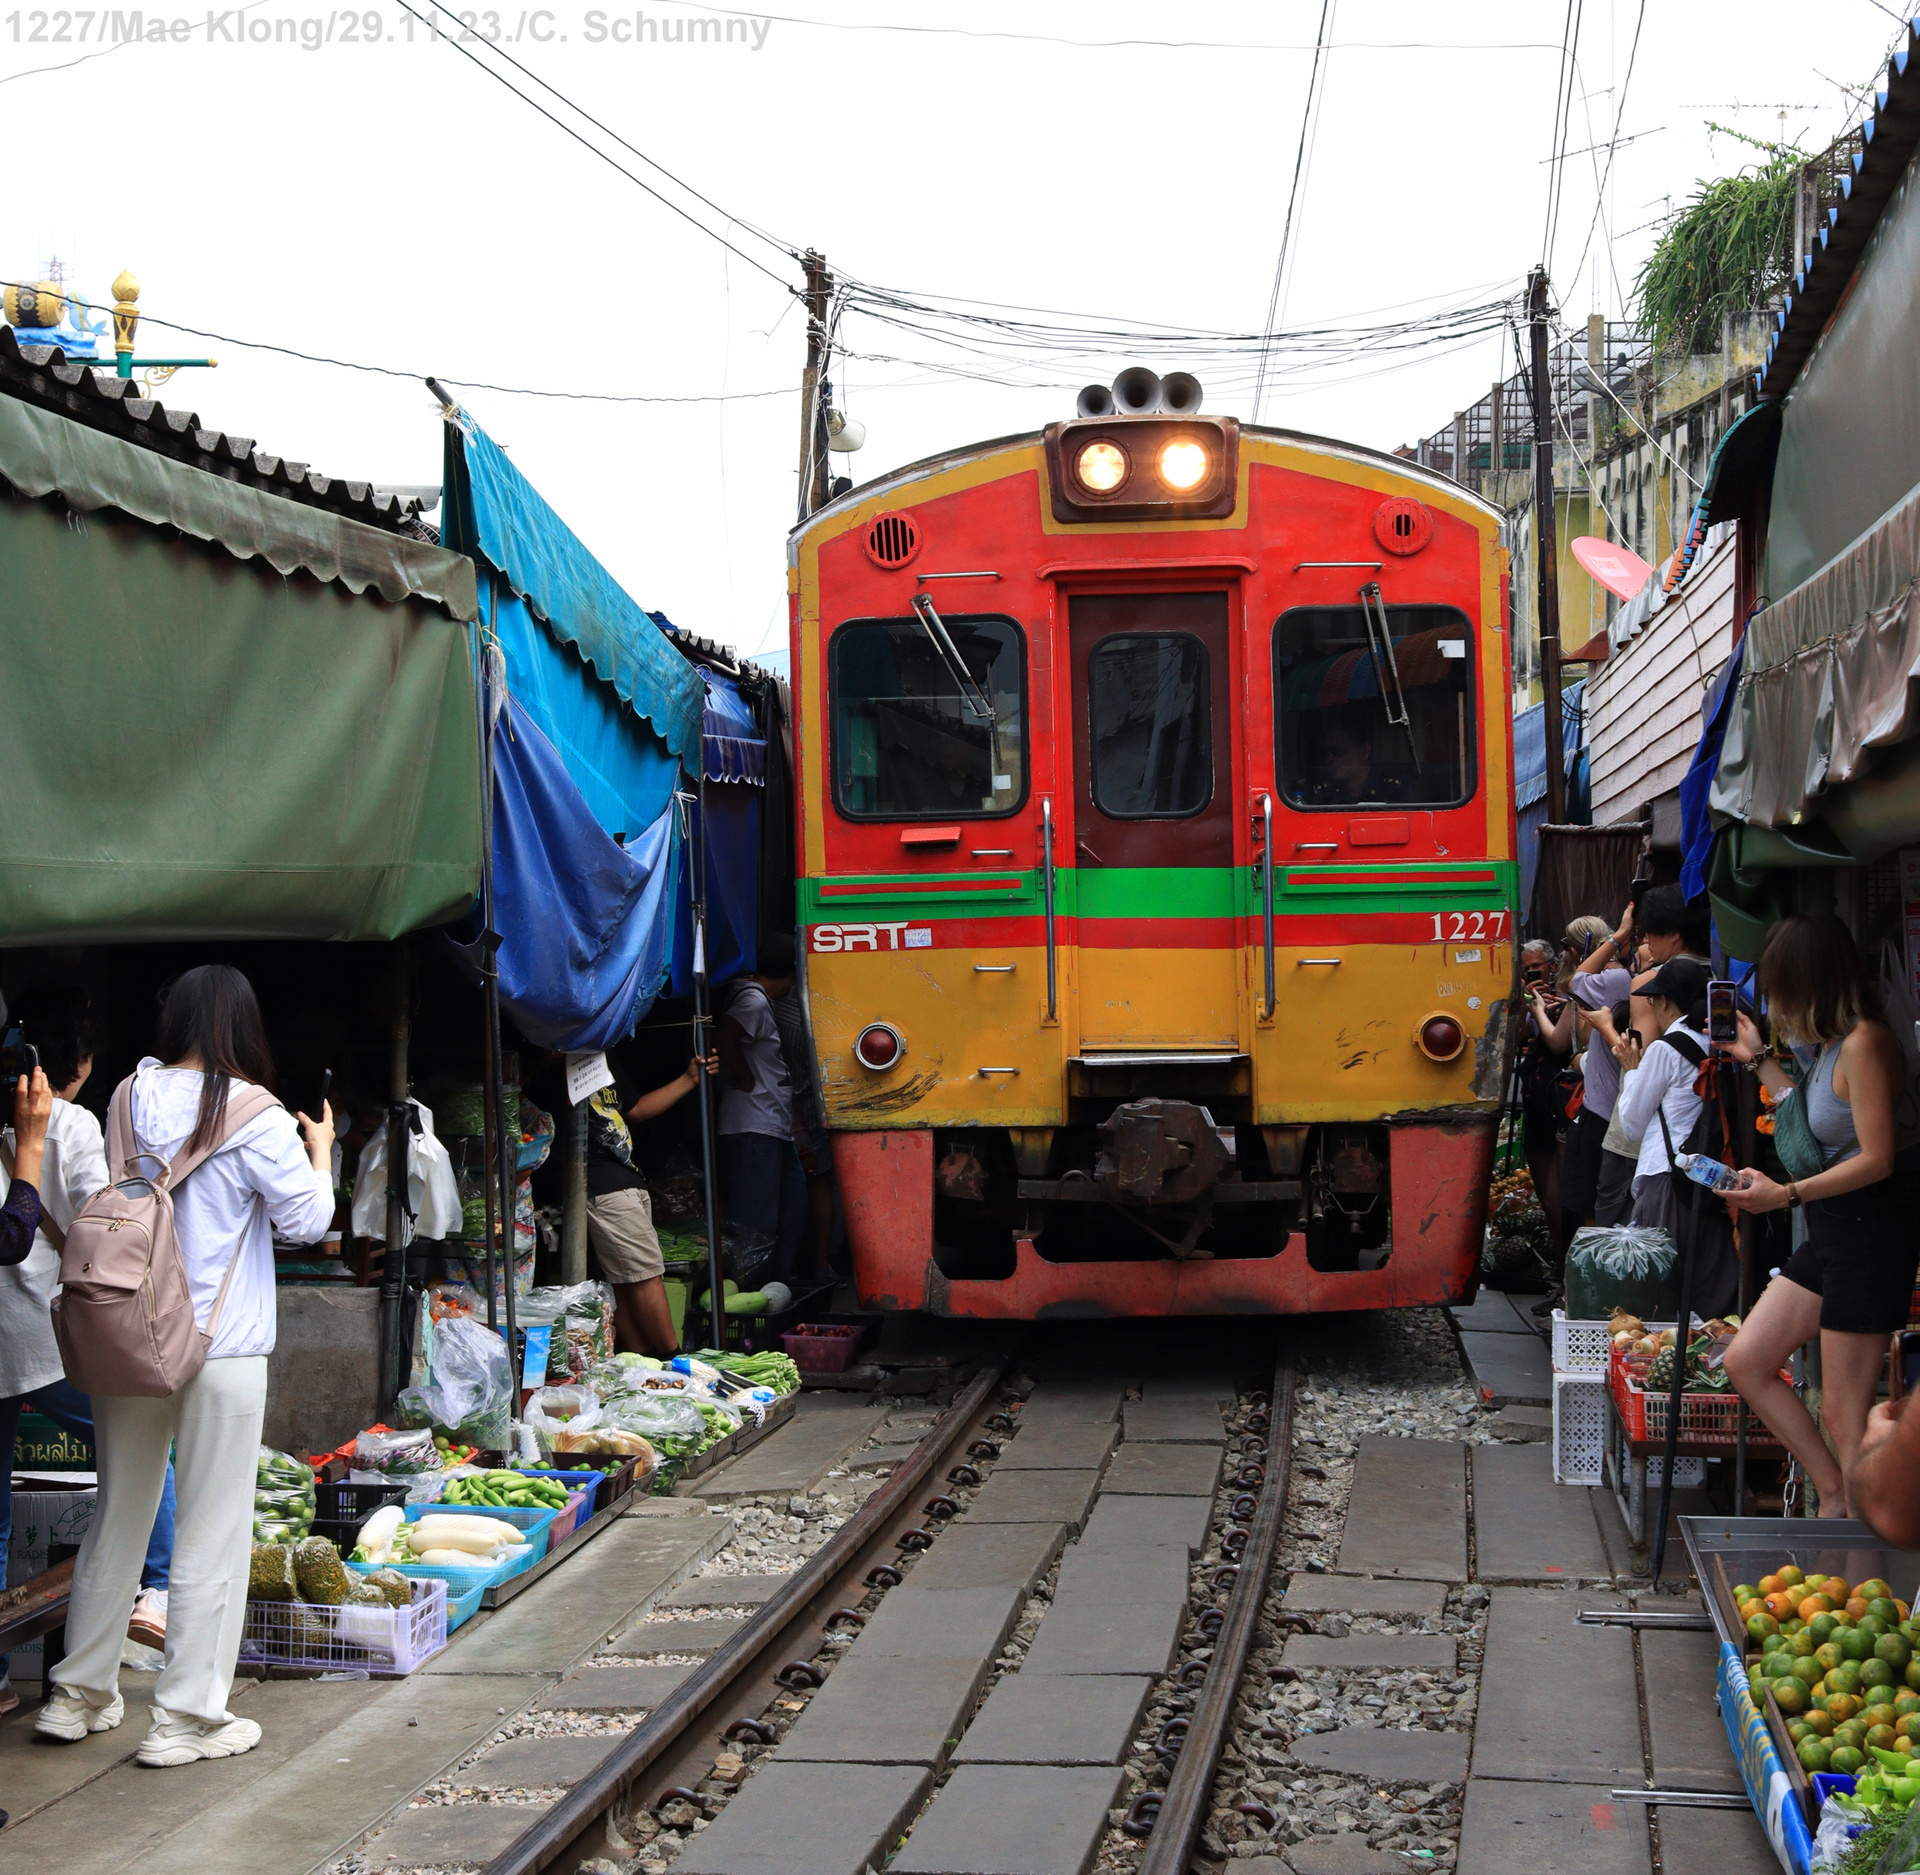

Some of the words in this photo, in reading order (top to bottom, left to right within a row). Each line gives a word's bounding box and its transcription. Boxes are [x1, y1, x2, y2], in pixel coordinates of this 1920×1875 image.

[1429, 911, 1506, 941] 1227
[812, 921, 909, 953] SRT
[17, 1549, 49, 1560] RADIS
[10, 1643, 42, 1654] ADIS
